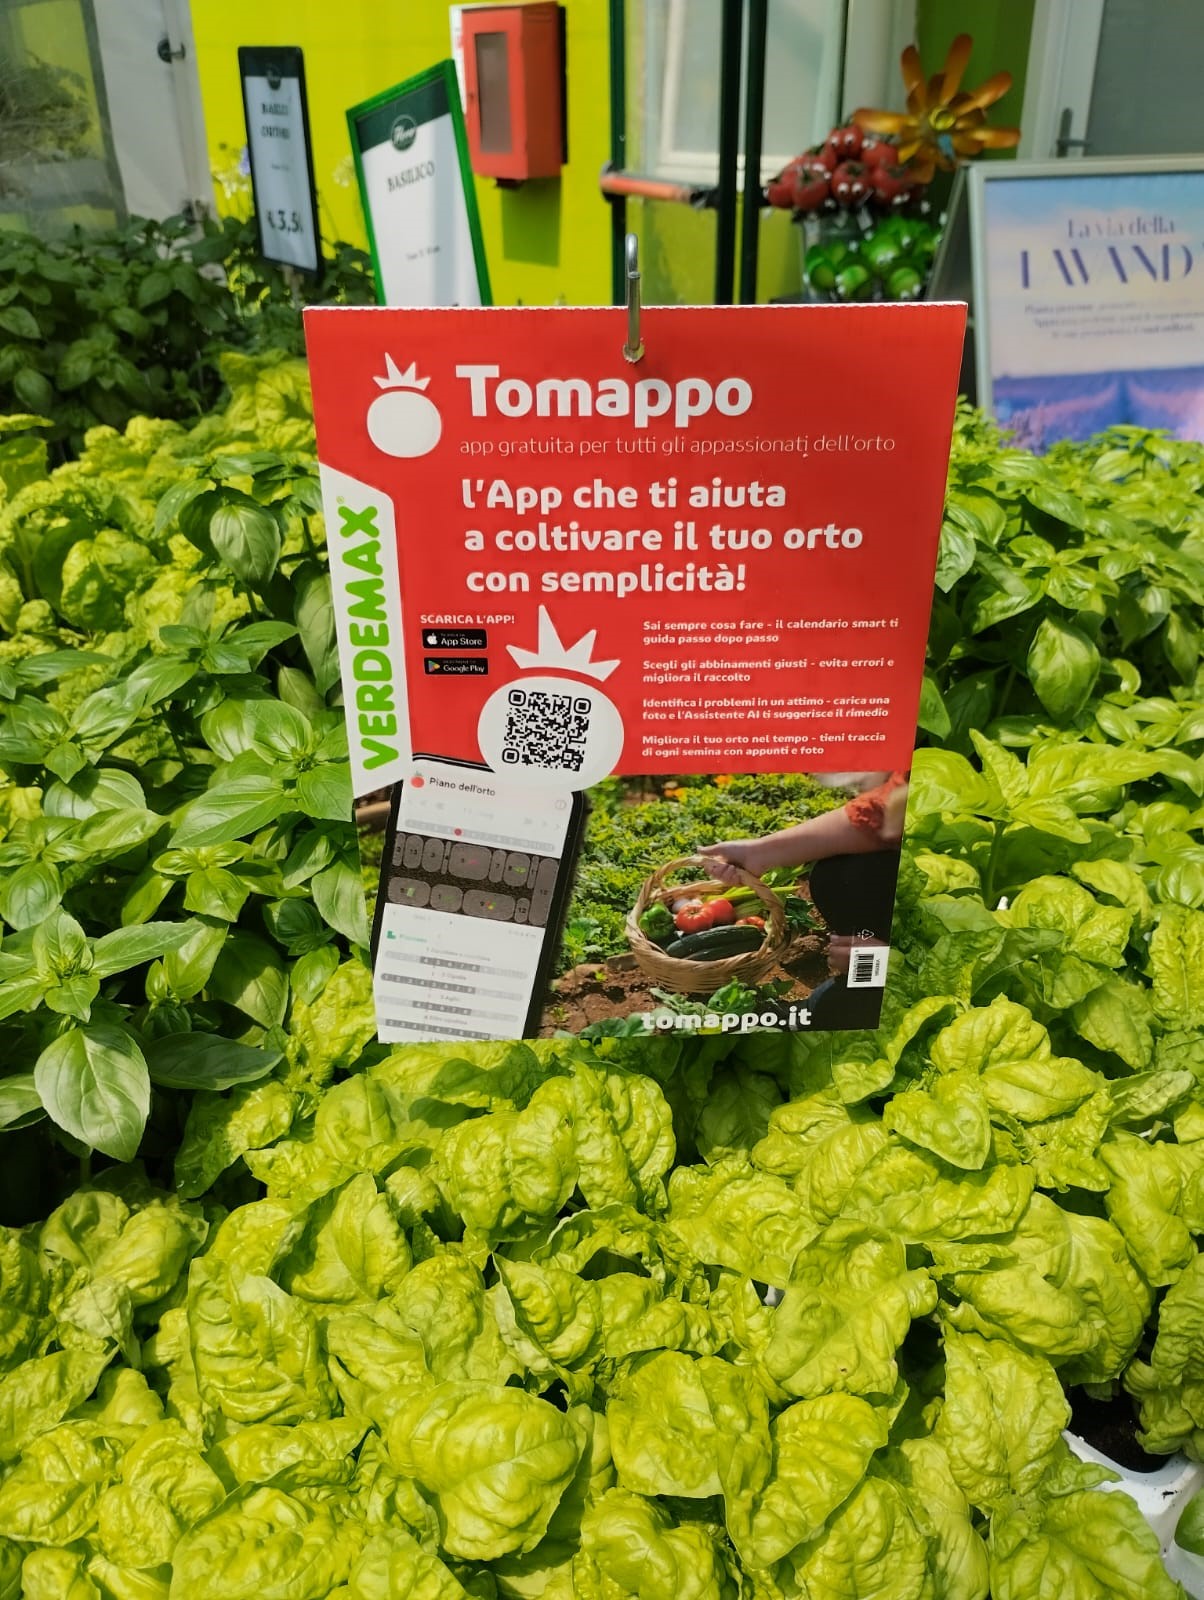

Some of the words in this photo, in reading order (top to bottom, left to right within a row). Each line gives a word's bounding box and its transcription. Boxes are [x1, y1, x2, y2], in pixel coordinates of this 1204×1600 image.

[1067, 218, 1090, 239] La
[1128, 214, 1176, 236] della
[455, 364, 752, 428] Tomappo
[460, 439, 494, 456] app
[498, 436, 574, 457] gratuita
[580, 440, 609, 456] per
[616, 436, 656, 453] tutti
[662, 435, 684, 456] gli
[690, 435, 808, 456] appassionati
[814, 434, 896, 452] dell'orto
[462, 478, 563, 515] l'App
[573, 478, 638, 508] che
[649, 477, 677, 508] ti
[689, 476, 787, 508] aiuta
[464, 529, 485, 551] a
[495, 520, 663, 551] coltivare
[674, 520, 698, 551] il
[709, 523, 773, 550] tuo
[783, 523, 863, 549] orto
[466, 571, 530, 592] con
[541, 562, 746, 598] semplicità!
[420, 615, 473, 624] SCARICA
[476, 615, 515, 624] L'APP!
[643, 620, 661, 630] Sai
[664, 621, 707, 632] sempre
[710, 621, 736, 630] cosa
[740, 620, 764, 630] fare
[775, 619, 783, 629] il
[787, 619, 849, 629] calendario
[851, 619, 886, 628] smart
[890, 618, 899, 628] ti
[337, 505, 399, 770] VERDEMAX
[440, 638, 461, 646] App
[462, 638, 483, 646] Store
[643, 633, 676, 645] guida
[678, 635, 712, 645] passo
[714, 634, 743, 645] dopo
[745, 634, 779, 645] passo
[443, 664, 469, 673] Google
[470, 664, 485, 673] Play
[643, 659, 678, 671] Scegli
[681, 660, 696, 671] gli
[699, 659, 771, 669] abbinamenti
[774, 658, 807, 670] giusti
[819, 658, 848, 668] evita
[851, 657, 884, 667] errori
[887, 659, 894, 667] e
[643, 673, 691, 684] migliora
[693, 672, 702, 682] il
[704, 672, 751, 682] raccolto
[643, 697, 697, 708] Identifica
[698, 697, 702, 707] i
[704, 697, 756, 709] problemi
[757, 697, 768, 706] in
[787, 696, 824, 706] attimo
[833, 696, 867, 706] carica
[869, 697, 890, 705] una
[642, 710, 667, 720] foto
[677, 709, 745, 720] l'Assistente
[762, 709, 771, 719] ti
[773, 709, 833, 720] suggerisce
[835, 708, 843, 718] il
[845, 708, 889, 718] rimedio
[642, 734, 690, 746] Migliora
[693, 734, 701, 744] il
[703, 735, 722, 744] tuo
[725, 735, 749, 744] orto
[752, 734, 770, 743] nel
[772, 734, 809, 745] tempo
[819, 733, 845, 743] tieni
[847, 732, 886, 742] traccia
[642, 747, 652, 757] di
[655, 747, 680, 758] ogni
[682, 747, 721, 757] semina
[724, 748, 743, 756] con
[745, 746, 789, 757] appunti
[800, 745, 824, 755] foto
[429, 777, 456, 790] Piano
[458, 781, 496, 797] dell'orto
[641, 1006, 811, 1031] tomappo.it
